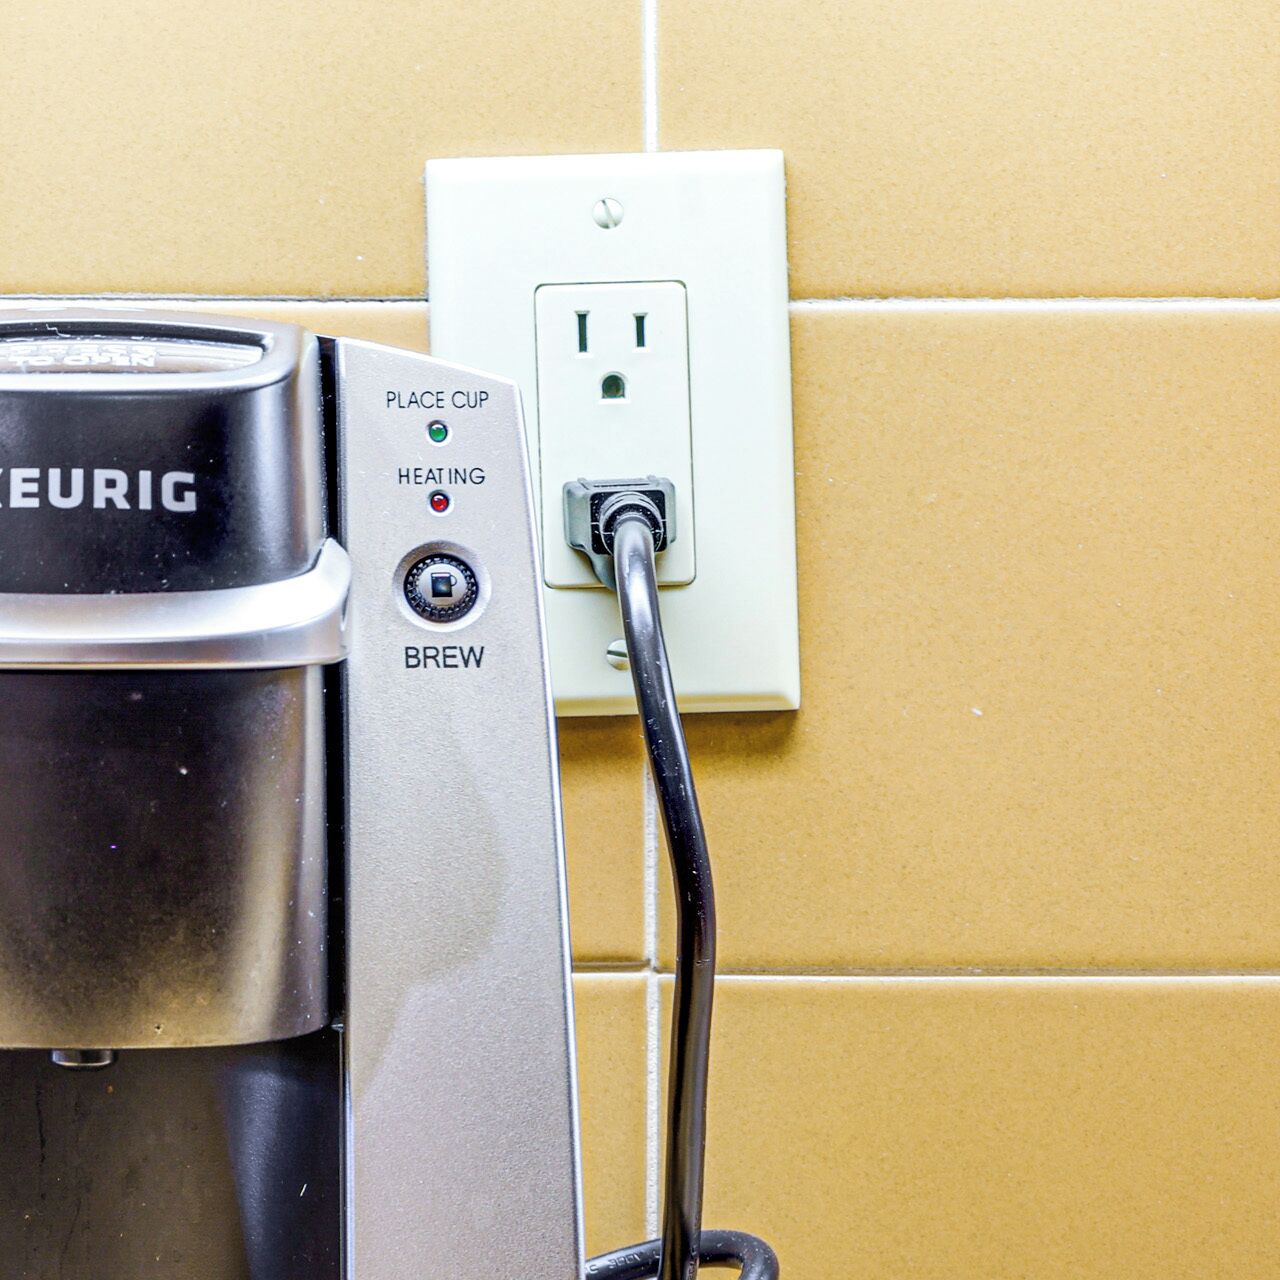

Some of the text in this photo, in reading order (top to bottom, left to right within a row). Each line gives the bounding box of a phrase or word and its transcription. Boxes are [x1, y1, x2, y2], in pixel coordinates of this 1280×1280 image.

[386, 391, 490, 409] PLACE CUP
[398, 468, 486, 485] HEATING
[405, 646, 485, 669] BREW
